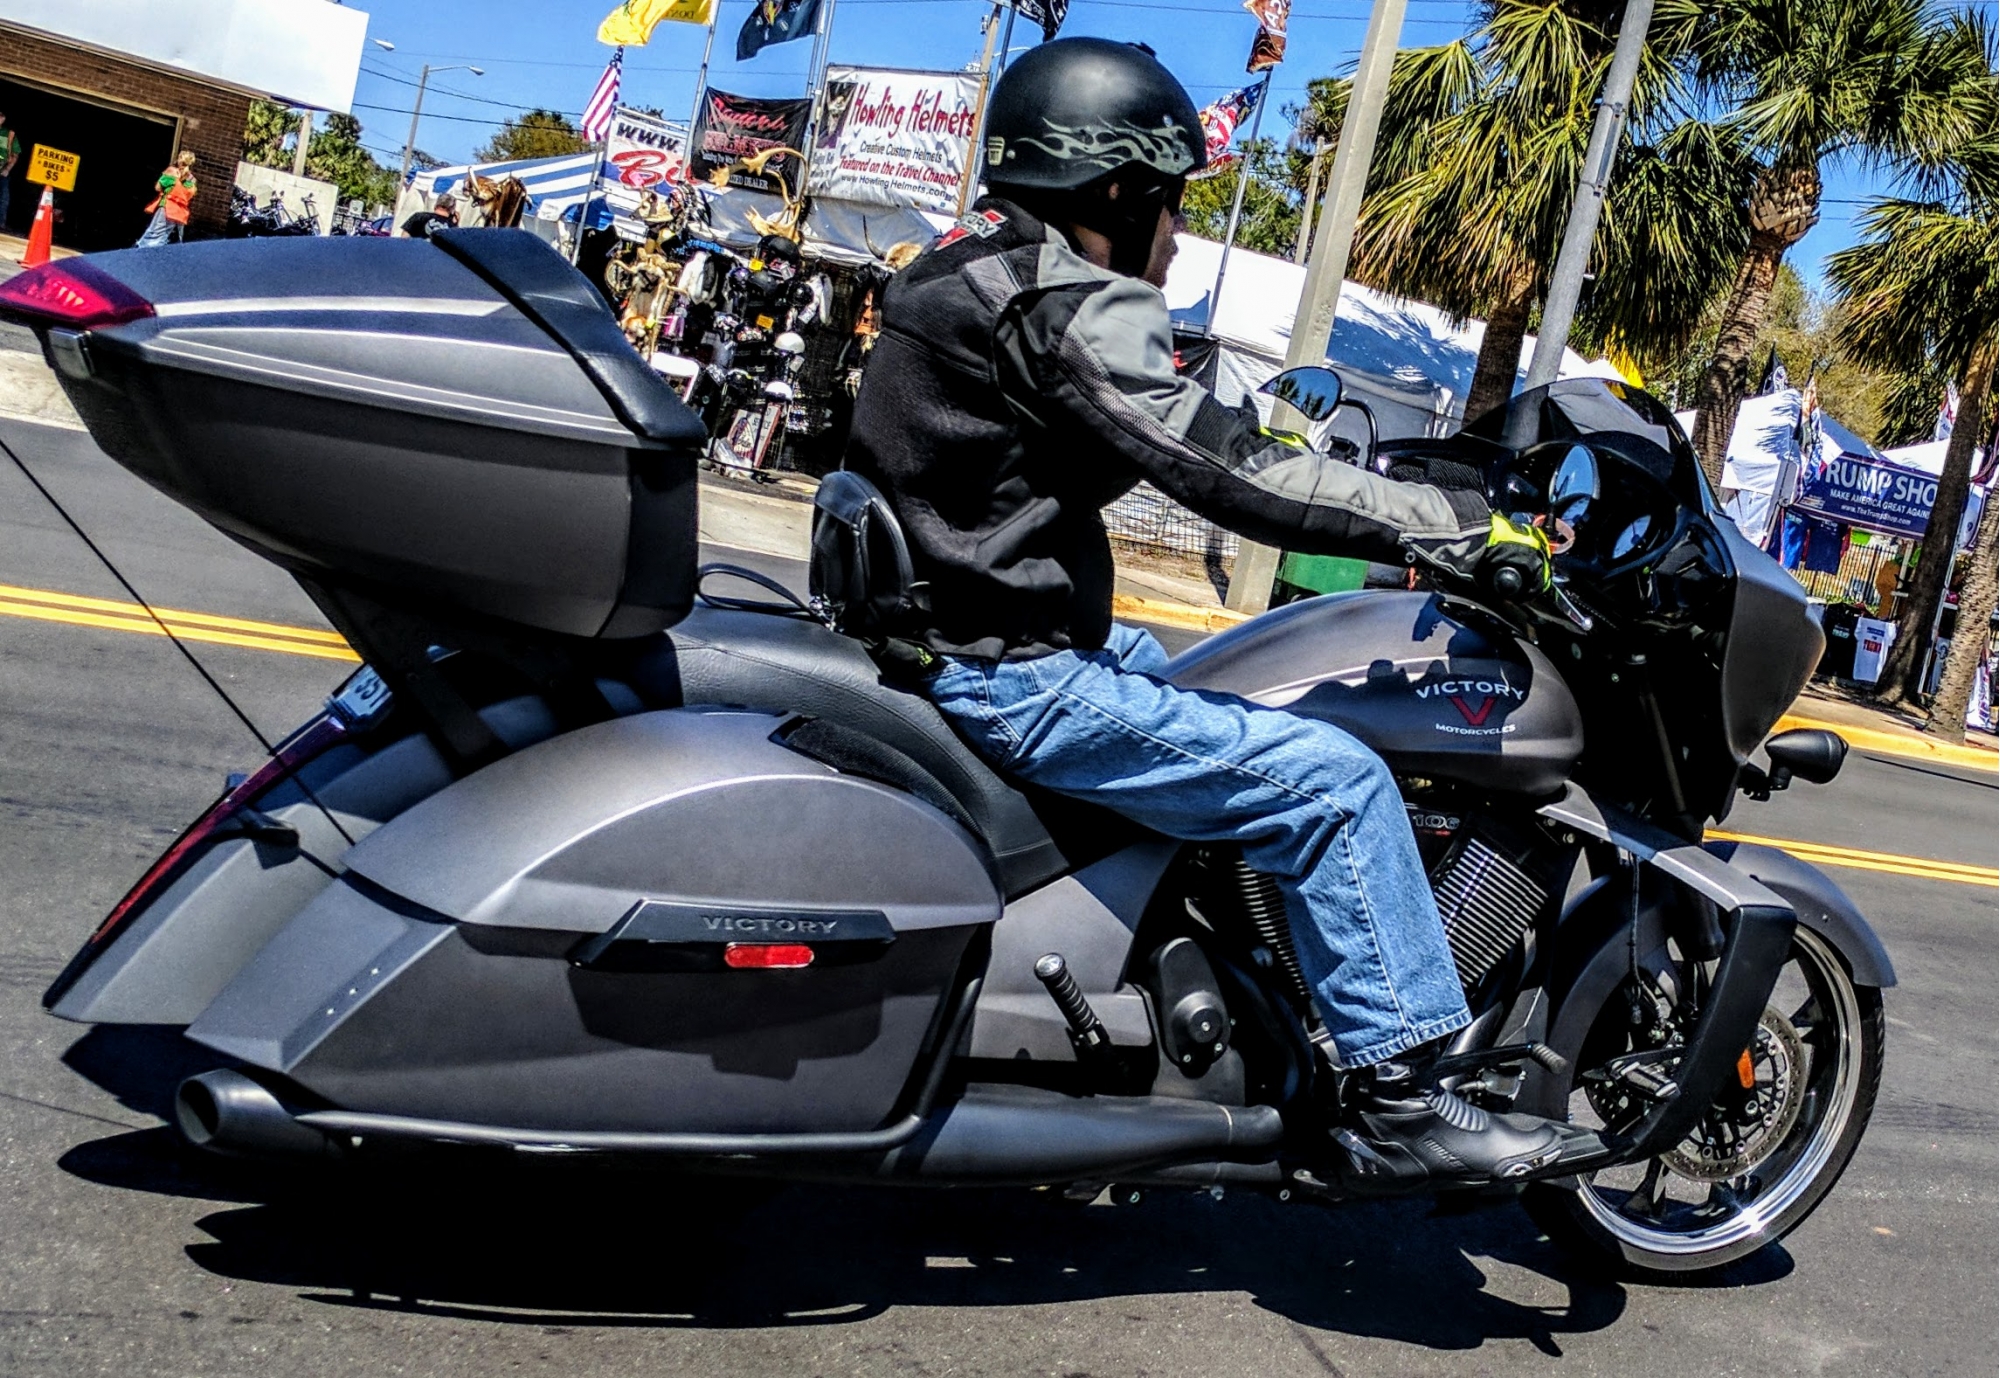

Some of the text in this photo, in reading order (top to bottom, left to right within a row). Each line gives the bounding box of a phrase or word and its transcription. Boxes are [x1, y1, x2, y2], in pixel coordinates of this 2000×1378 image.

[851, 82, 905, 138] Howling
[906, 89, 974, 138] Helmets
[617, 122, 680, 153] www.
[38, 148, 74, 164] PARKING
[860, 140, 942, 164] Creative Custom Helmets
[43, 160, 65, 172] BIKES
[45, 170, 59, 181] $5
[869, 162, 881, 173] on
[880, 161, 895, 176] the
[895, 163, 922, 181] Travel
[923, 166, 961, 187] Channel
[1830, 488, 1851, 500] MAKE
[1851, 493, 1881, 508] AMERICA
[1882, 501, 1906, 514] GREAT
[1416, 681, 1523, 700] VICTORY
[1435, 723, 1516, 735] MOTORCYCLES
[702, 916, 837, 934] VICTORY
